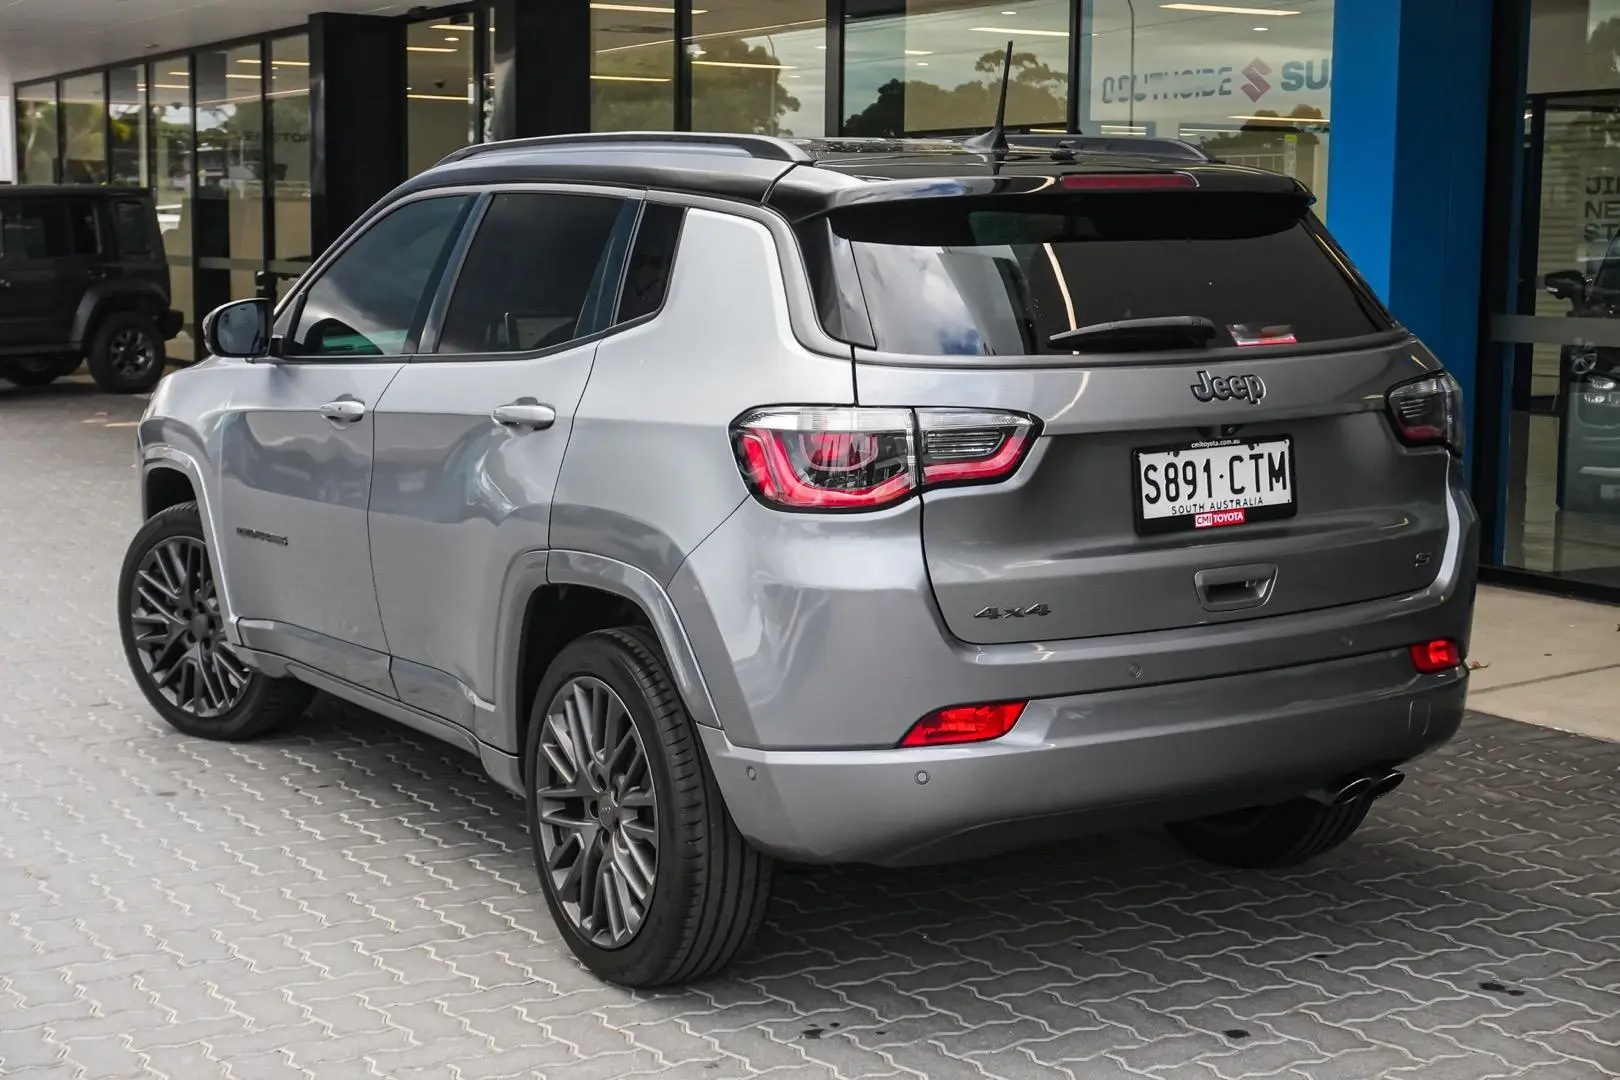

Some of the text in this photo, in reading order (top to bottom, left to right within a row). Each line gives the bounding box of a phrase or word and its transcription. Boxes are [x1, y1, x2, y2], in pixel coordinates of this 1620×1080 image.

[1281, 58, 1332, 91] SU
[1585, 176, 1620, 195] JI
[1191, 370, 1267, 405] Jeep
[1171, 497, 1264, 515] SOUTH AUSTRALIA
[1213, 511, 1244, 523] TOYOTA
[974, 603, 1051, 619] 4x4
